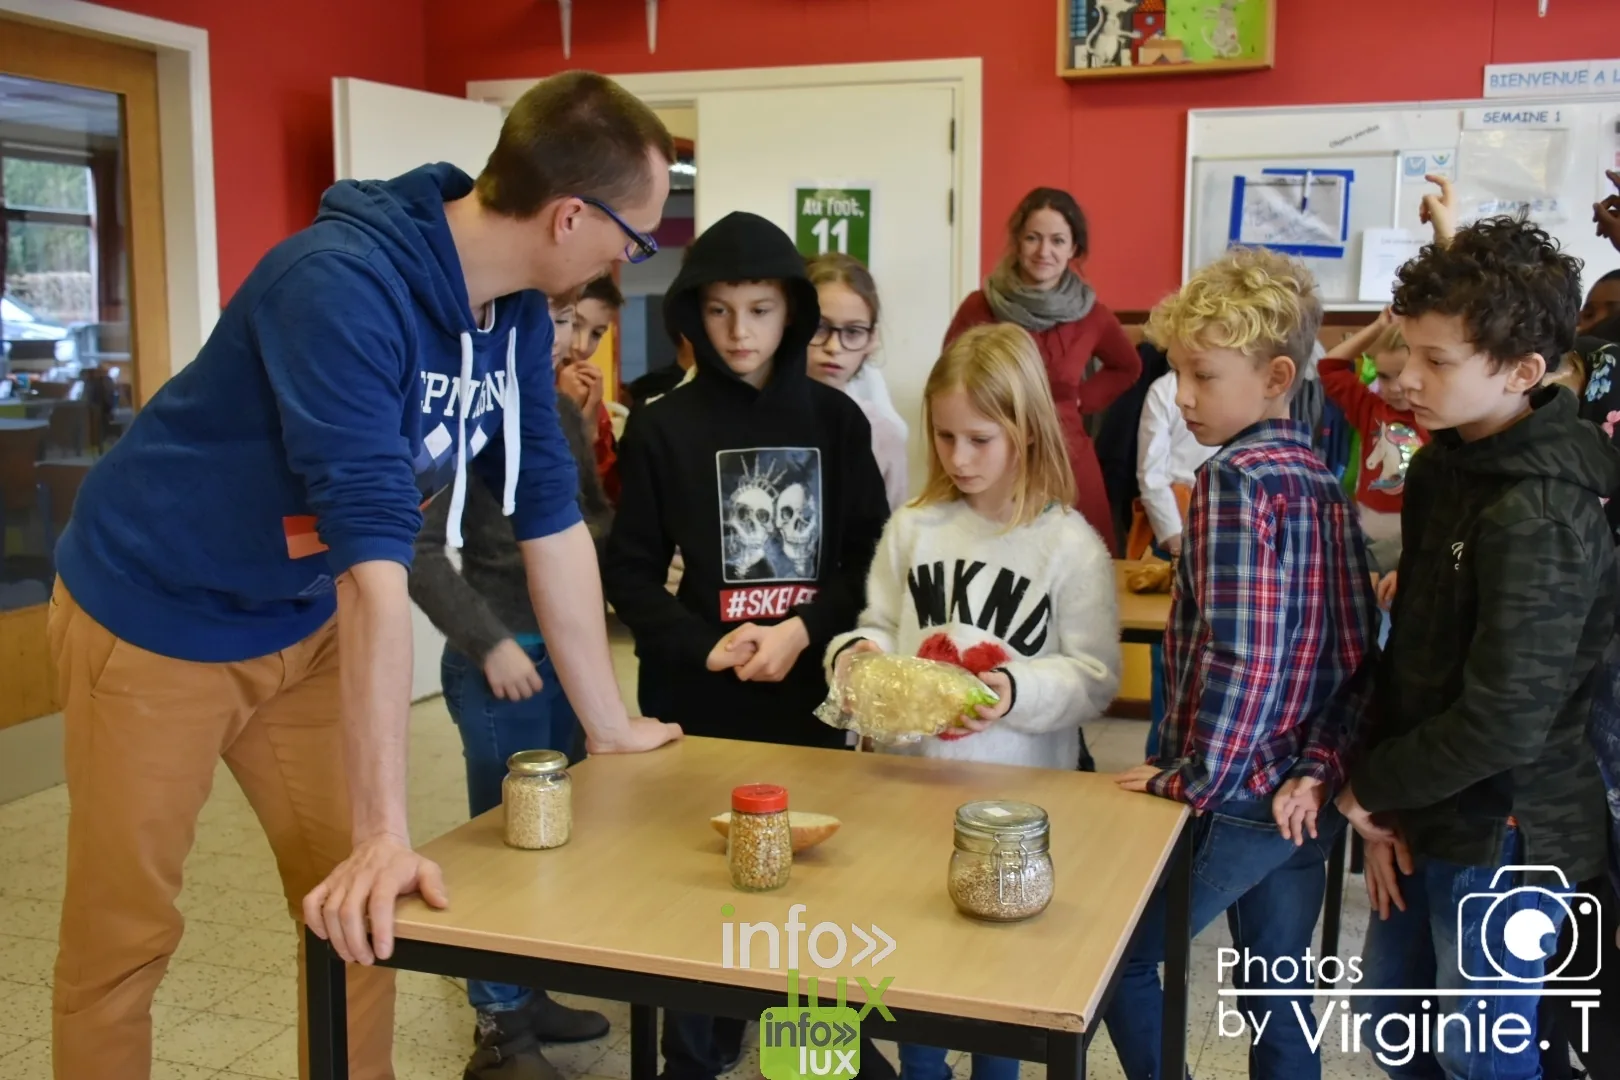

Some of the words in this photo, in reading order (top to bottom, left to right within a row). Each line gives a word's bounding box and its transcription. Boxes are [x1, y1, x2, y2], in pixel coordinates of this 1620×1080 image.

[1489, 70, 1588, 88] BIENVENUE
[1483, 111, 1548, 123] SEMAINE
[1555, 111, 1562, 122] 1
[1549, 199, 1557, 212] 2
[811, 218, 848, 256] 11
[907, 559, 1051, 657] WKND
